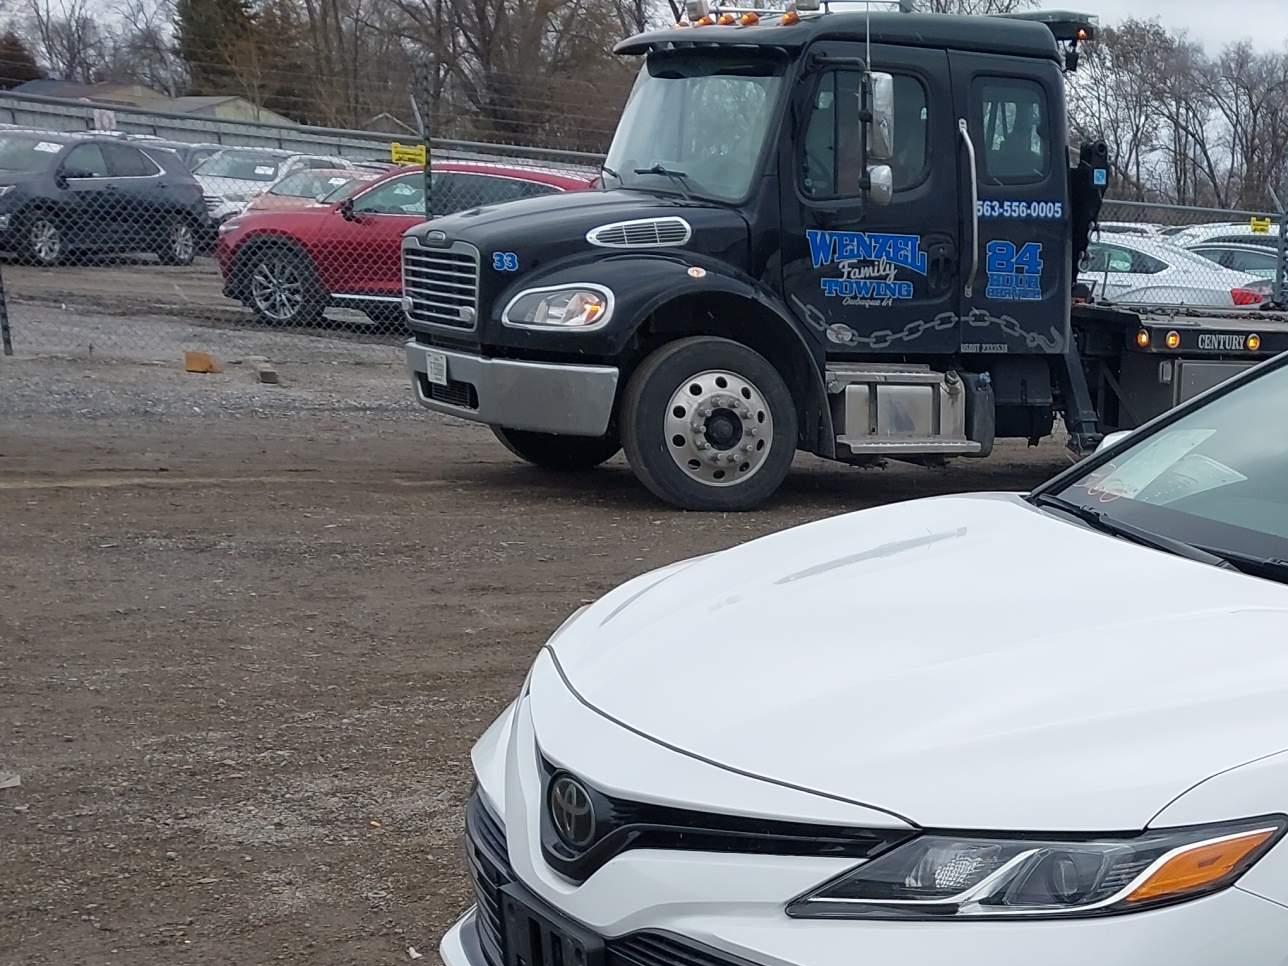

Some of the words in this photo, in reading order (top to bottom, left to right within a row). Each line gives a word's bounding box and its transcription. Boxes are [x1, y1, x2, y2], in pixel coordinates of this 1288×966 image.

[976, 201, 1062, 217] 563-556-0005
[493, 252, 518, 271] 33
[806, 230, 928, 276] WENZEL
[838, 257, 898, 284] Family
[820, 278, 914, 299] TOWING
[1198, 334, 1246, 349] CENTURY
